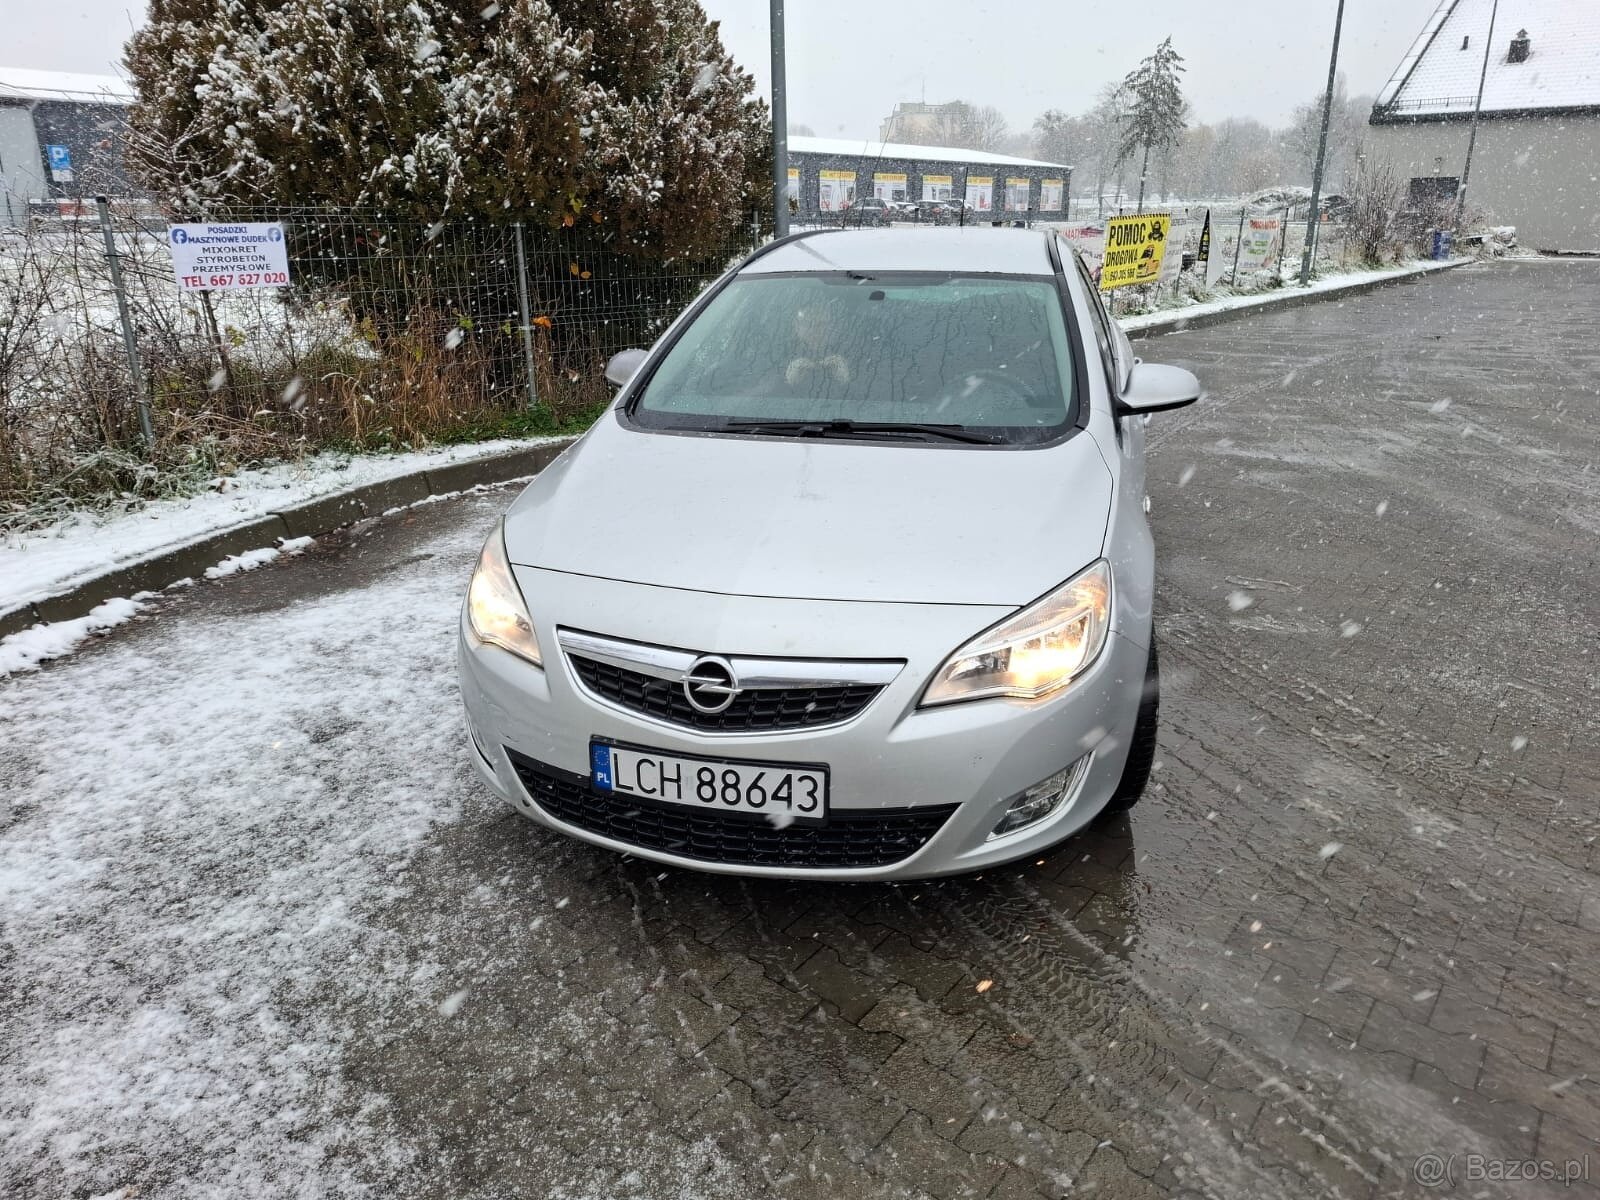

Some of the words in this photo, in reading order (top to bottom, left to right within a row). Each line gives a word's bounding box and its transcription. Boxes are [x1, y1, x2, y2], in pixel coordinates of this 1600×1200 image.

[207, 226, 248, 234] POSADZKI
[1108, 222, 1147, 247] POMOC
[188, 235, 239, 244] MASZYNOWE
[241, 234, 267, 243] DUDEK
[202, 245, 258, 254] MIXOKRET
[196, 254, 266, 264] STYROBETON
[1105, 248, 1139, 268] DROGOWA
[192, 263, 272, 273] PRZEMYSŁOWE
[182, 275, 206, 288] TEL
[210, 274, 233, 286] 667
[264, 271, 286, 284] 020
[597, 772, 610, 784] PL
[613, 752, 682, 800] LCH
[696, 766, 818, 813] 88643
